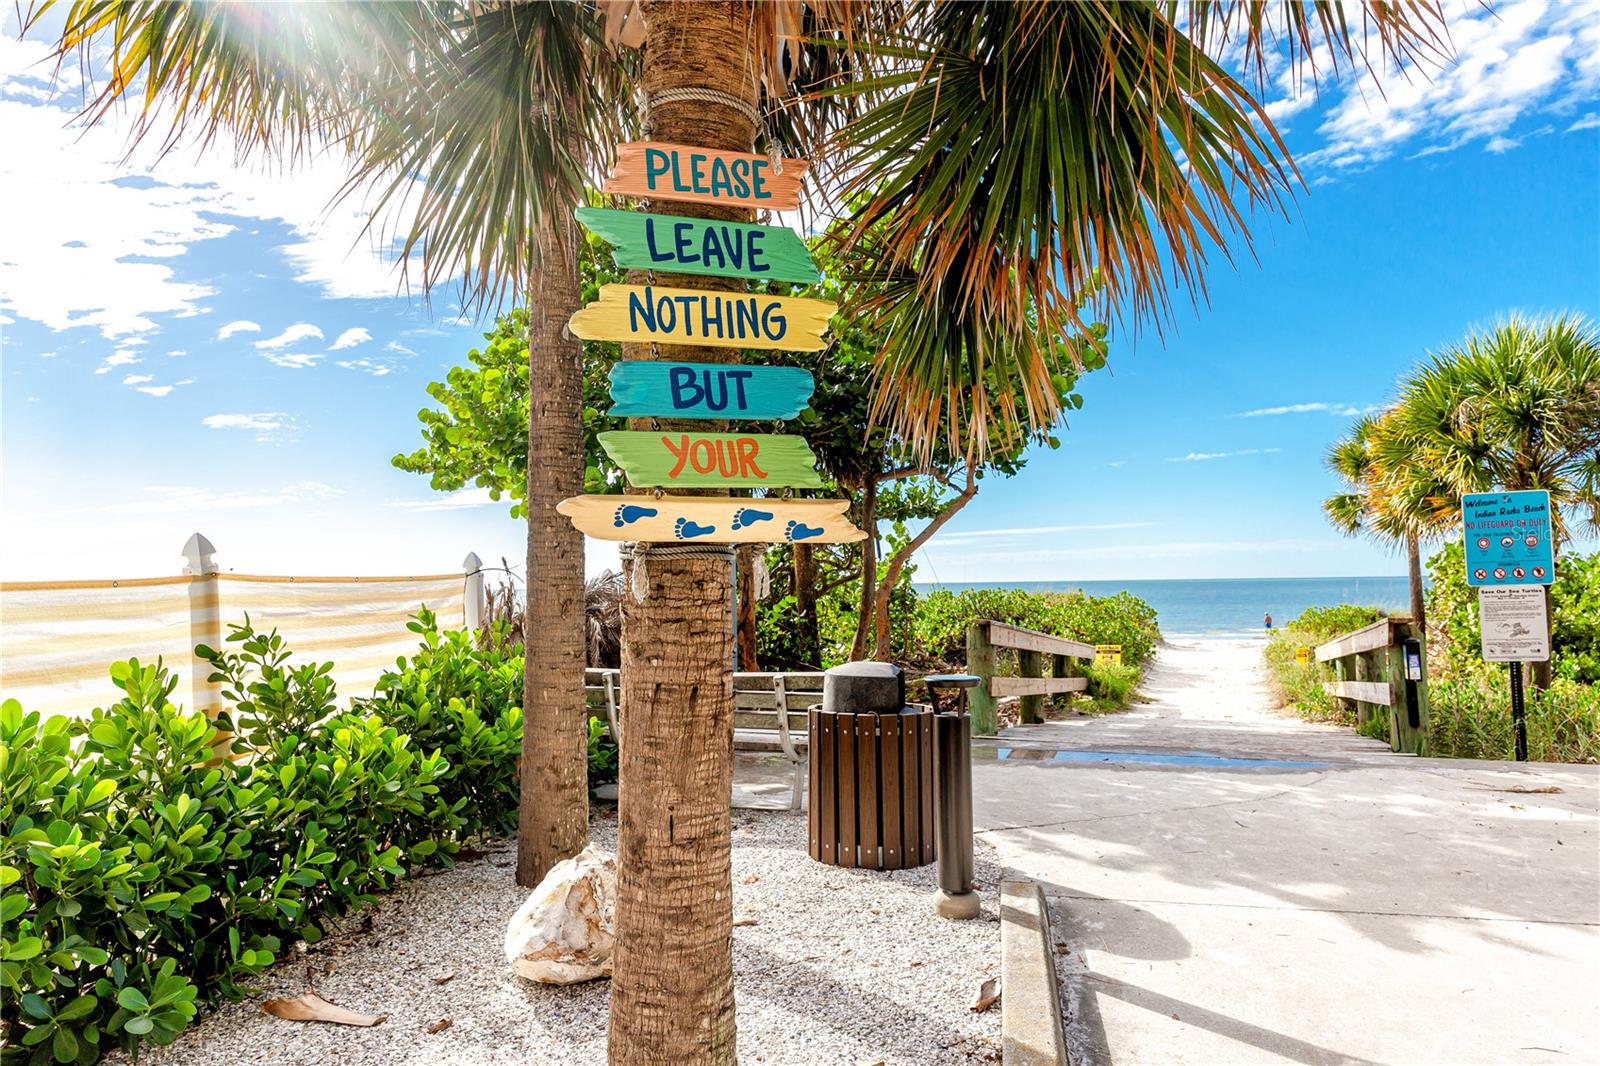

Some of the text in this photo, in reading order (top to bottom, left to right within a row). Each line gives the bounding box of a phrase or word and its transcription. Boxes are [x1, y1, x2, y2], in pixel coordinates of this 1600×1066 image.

[645, 148, 772, 199] PLEASE
[645, 218, 770, 272] LEAVE
[628, 286, 787, 341] NOTHING
[669, 366, 752, 411] BUT
[661, 434, 768, 479] YOUR
[1465, 499, 1498, 508] Welcome
[1465, 518, 1548, 530] NO LIFEGUARD ON DUTY
[1475, 510, 1496, 518] Indian
[1524, 504, 1545, 513] Beach
